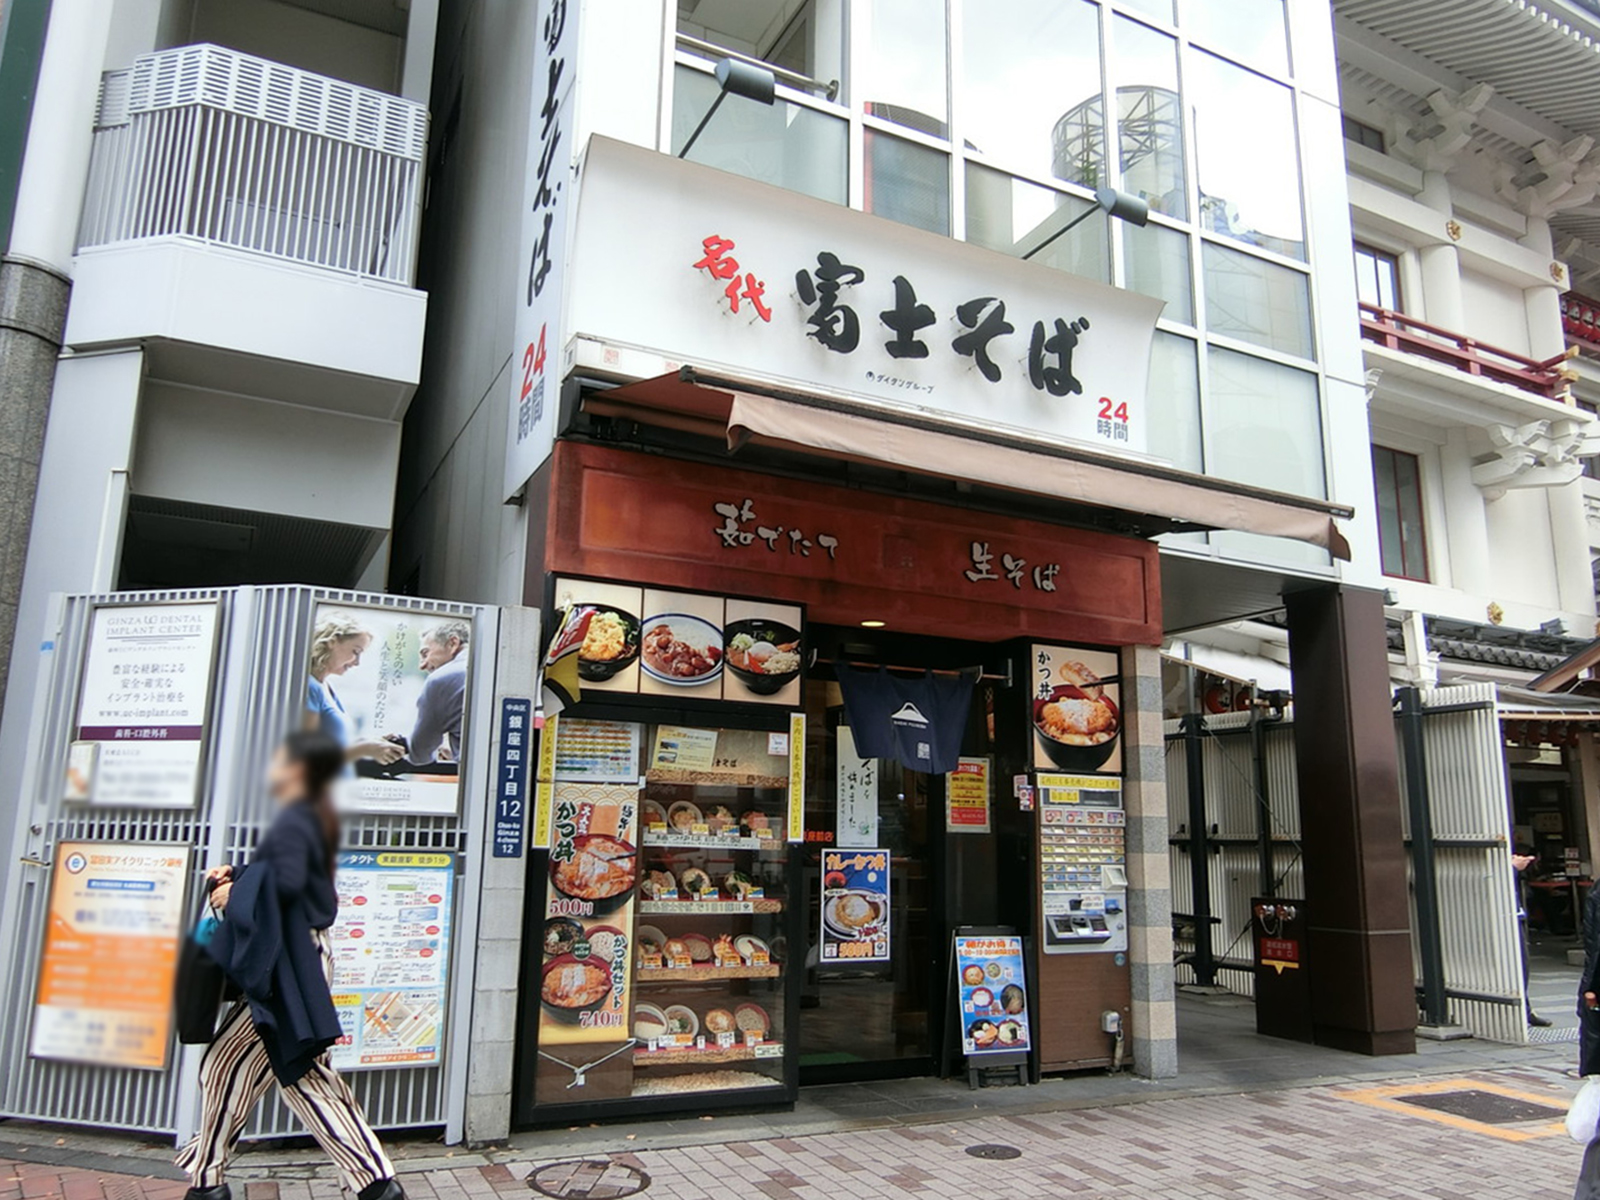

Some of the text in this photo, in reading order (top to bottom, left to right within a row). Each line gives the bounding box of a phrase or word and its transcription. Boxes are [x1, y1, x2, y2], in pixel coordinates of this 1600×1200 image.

[693, 234, 772, 324] 名代
[795, 251, 1090, 397] 富士そば
[520, 322, 546, 403] 24
[1097, 419, 1128, 442] 時間
[1098, 397, 1129, 423] 24
[714, 499, 838, 559] 茹でたて
[964, 542, 1061, 593] 生そば
[106, 624, 203, 636] IMPLANT CENTER
[107, 616, 141, 626] GINZA
[160, 614, 203, 624] DENTAL
[1037, 650, 1054, 699] かつ丼
[500, 715, 523, 817] 銀座四丁目 12
[502, 844, 514, 853] 12
[554, 802, 577, 862] かつ丼
[826, 854, 886, 871] カレーかつ丼
[548, 899, 594, 917] 500円
[611, 935, 627, 1011] かつ丼セット
[579, 1011, 624, 1028] 740円
